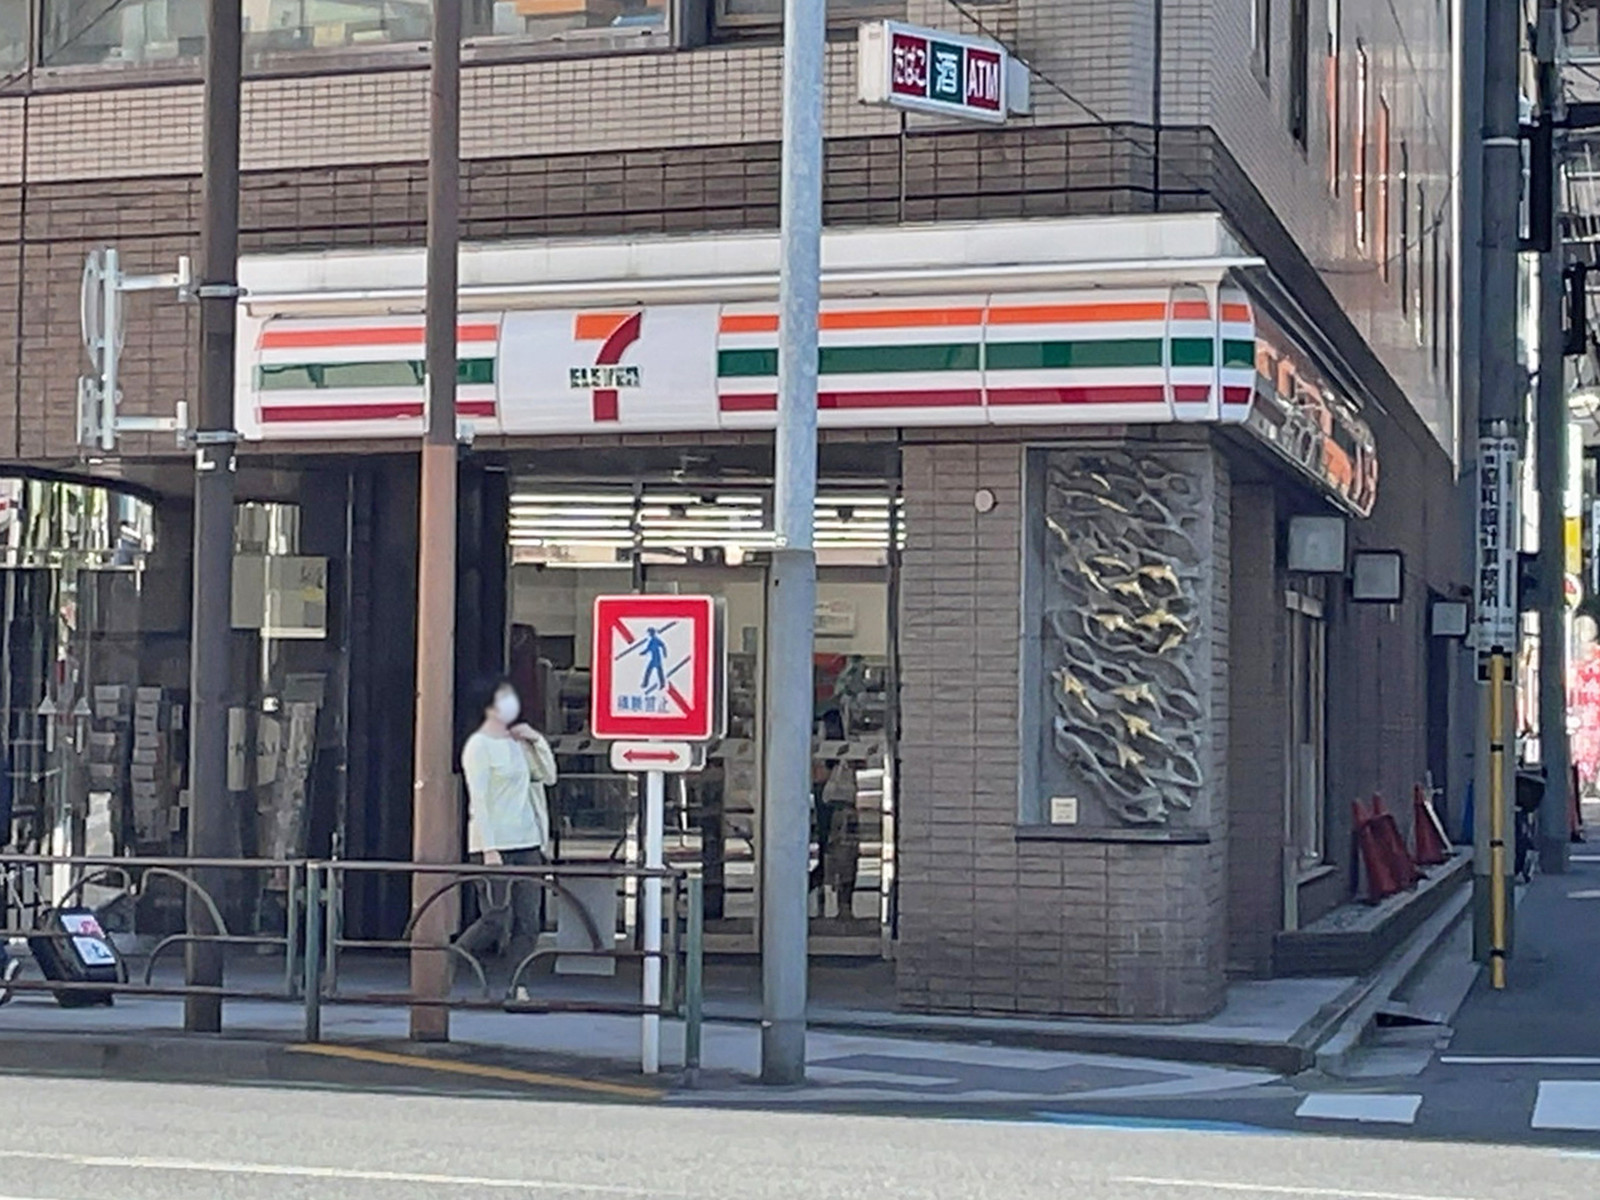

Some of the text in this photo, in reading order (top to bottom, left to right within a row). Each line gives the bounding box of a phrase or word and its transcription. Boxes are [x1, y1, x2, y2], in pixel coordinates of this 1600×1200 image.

[935, 51, 958, 94] 酒
[968, 59, 998, 101] ATM
[574, 311, 641, 422] 7
